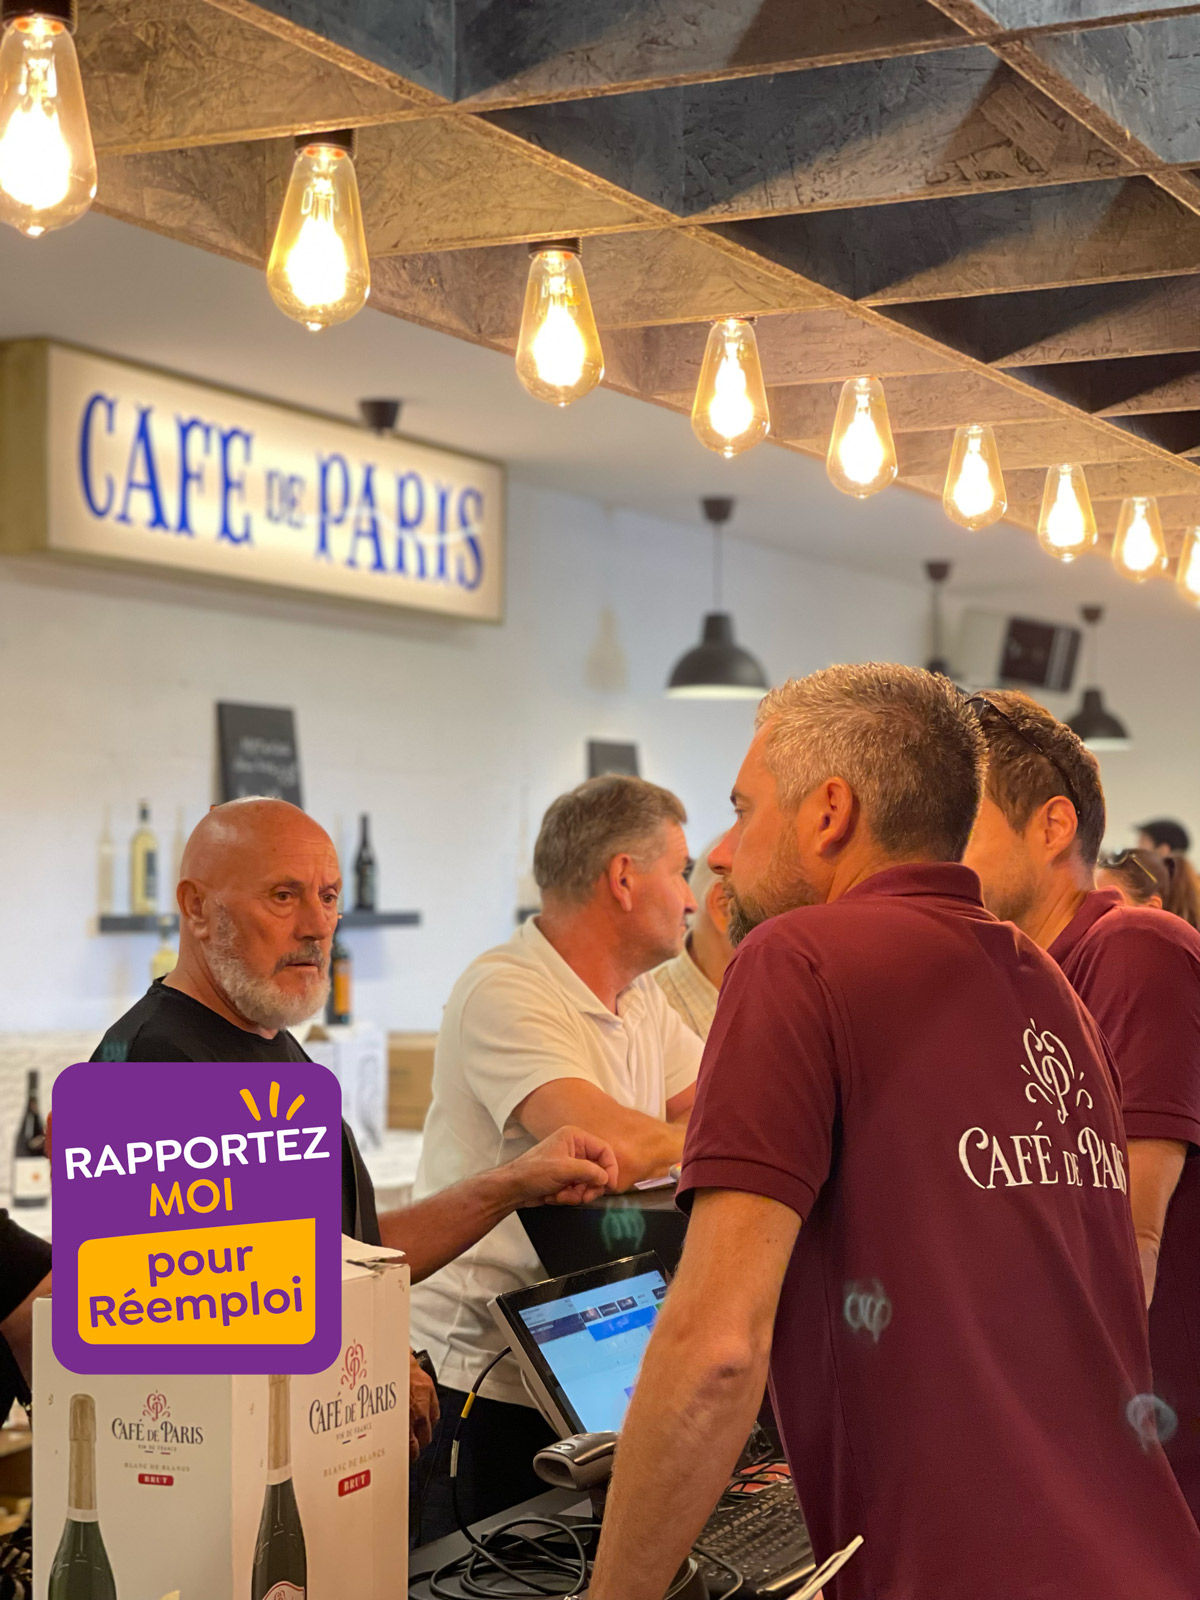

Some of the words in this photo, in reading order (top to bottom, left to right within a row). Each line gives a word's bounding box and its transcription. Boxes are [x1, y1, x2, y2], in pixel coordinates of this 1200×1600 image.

[77, 392, 255, 546] CAFE
[264, 467, 306, 529] DE
[315, 452, 485, 592] PARIS
[958, 1120, 1059, 1190] CAFÉ
[1062, 1150, 1083, 1187] DE
[309, 1391, 343, 1435] CAFÉ
[345, 1403, 356, 1425] DE
[357, 1381, 397, 1420] PARIS
[111, 1417, 145, 1441] CAFÉ
[147, 1429, 160, 1442] DE
[160, 1420, 204, 1445] PARIS
[143, 1475, 168, 1485] BRUT
[342, 1473, 367, 1493] BRUT
